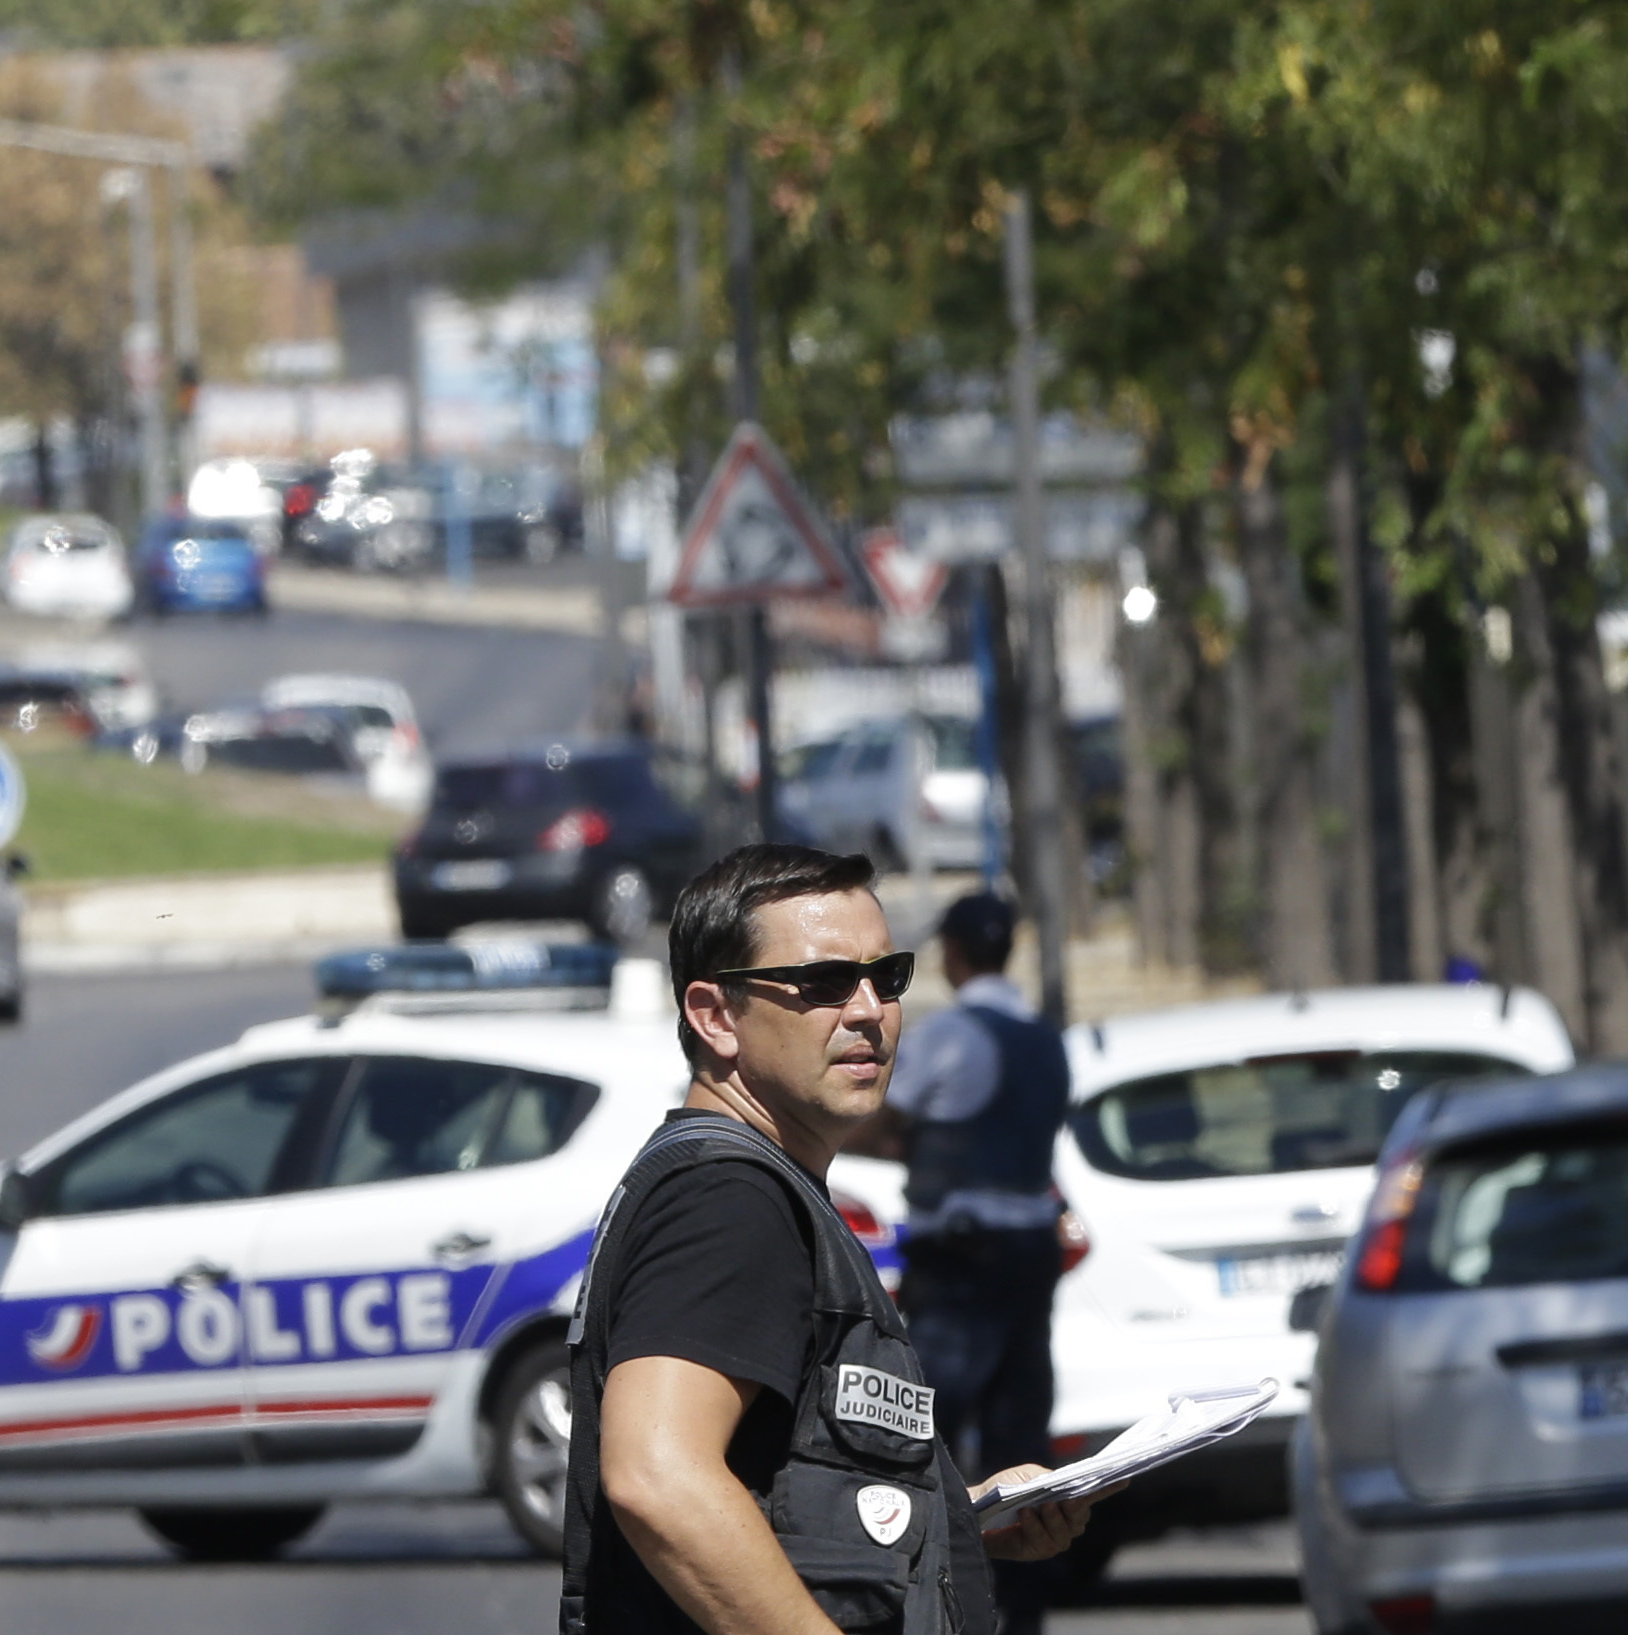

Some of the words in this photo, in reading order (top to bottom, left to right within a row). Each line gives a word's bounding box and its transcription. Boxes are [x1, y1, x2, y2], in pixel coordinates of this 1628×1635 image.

[112, 1273, 453, 1372] POLICE
[842, 1371, 931, 1415] POLICE
[840, 1401, 930, 1434] JUDICIAIRE
